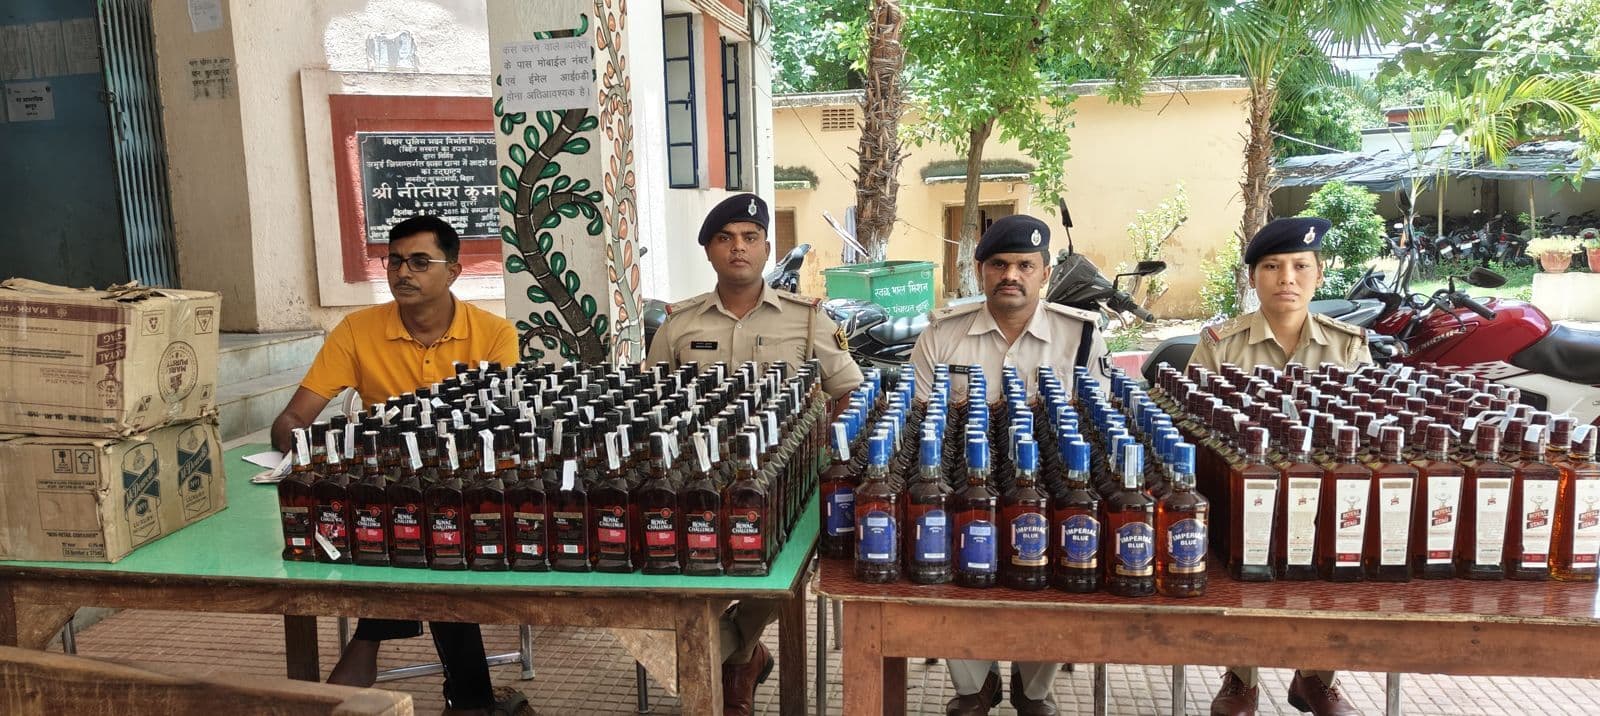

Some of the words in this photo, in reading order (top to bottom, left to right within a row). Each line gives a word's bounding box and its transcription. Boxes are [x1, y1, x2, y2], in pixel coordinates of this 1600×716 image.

[504, 60, 511, 70] के
[516, 60, 532, 69] पास
[406, 137, 425, 147] पुलिस
[372, 182, 392, 199] श्री
[397, 181, 460, 199] नीतीश
[464, 185, 498, 201] कुम
[17, 305, 48, 314] MARK
[1066, 528, 1096, 536] IMPERIAL
[1173, 532, 1203, 541] IMPERIAL
